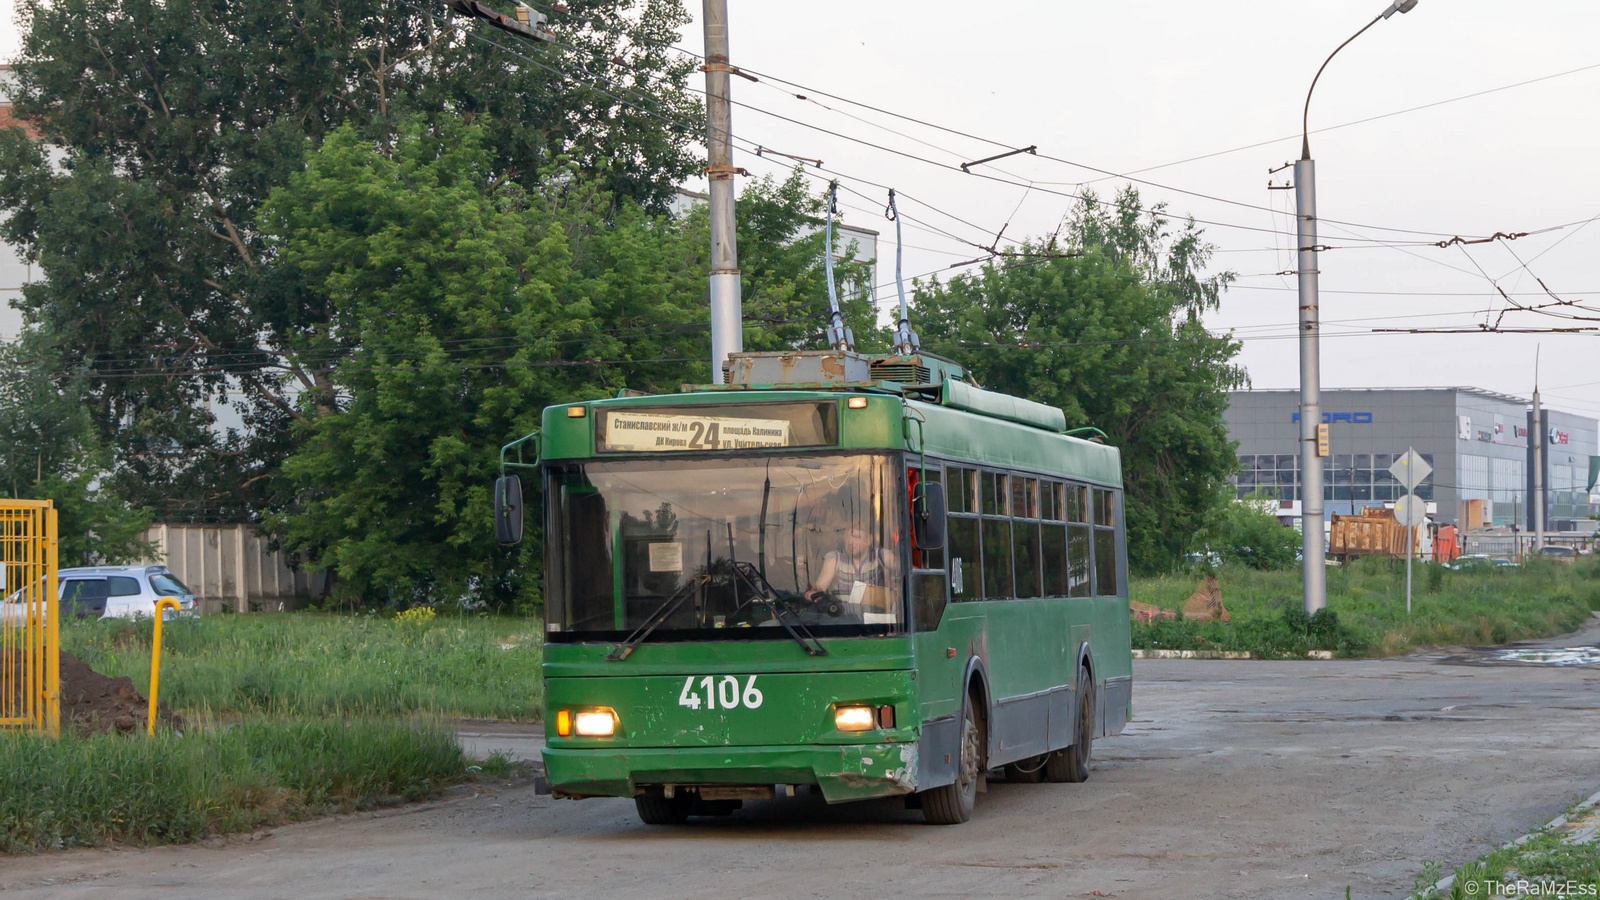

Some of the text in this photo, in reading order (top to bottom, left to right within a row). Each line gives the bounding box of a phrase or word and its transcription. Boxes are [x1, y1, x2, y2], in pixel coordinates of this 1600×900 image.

[614, 418, 688, 432] Станиславский ж/м
[722, 426, 782, 437] площадь Калинина
[655, 437, 687, 446] ДК Кирова
[688, 421, 720, 450] 24
[678, 675, 763, 709] 4106
